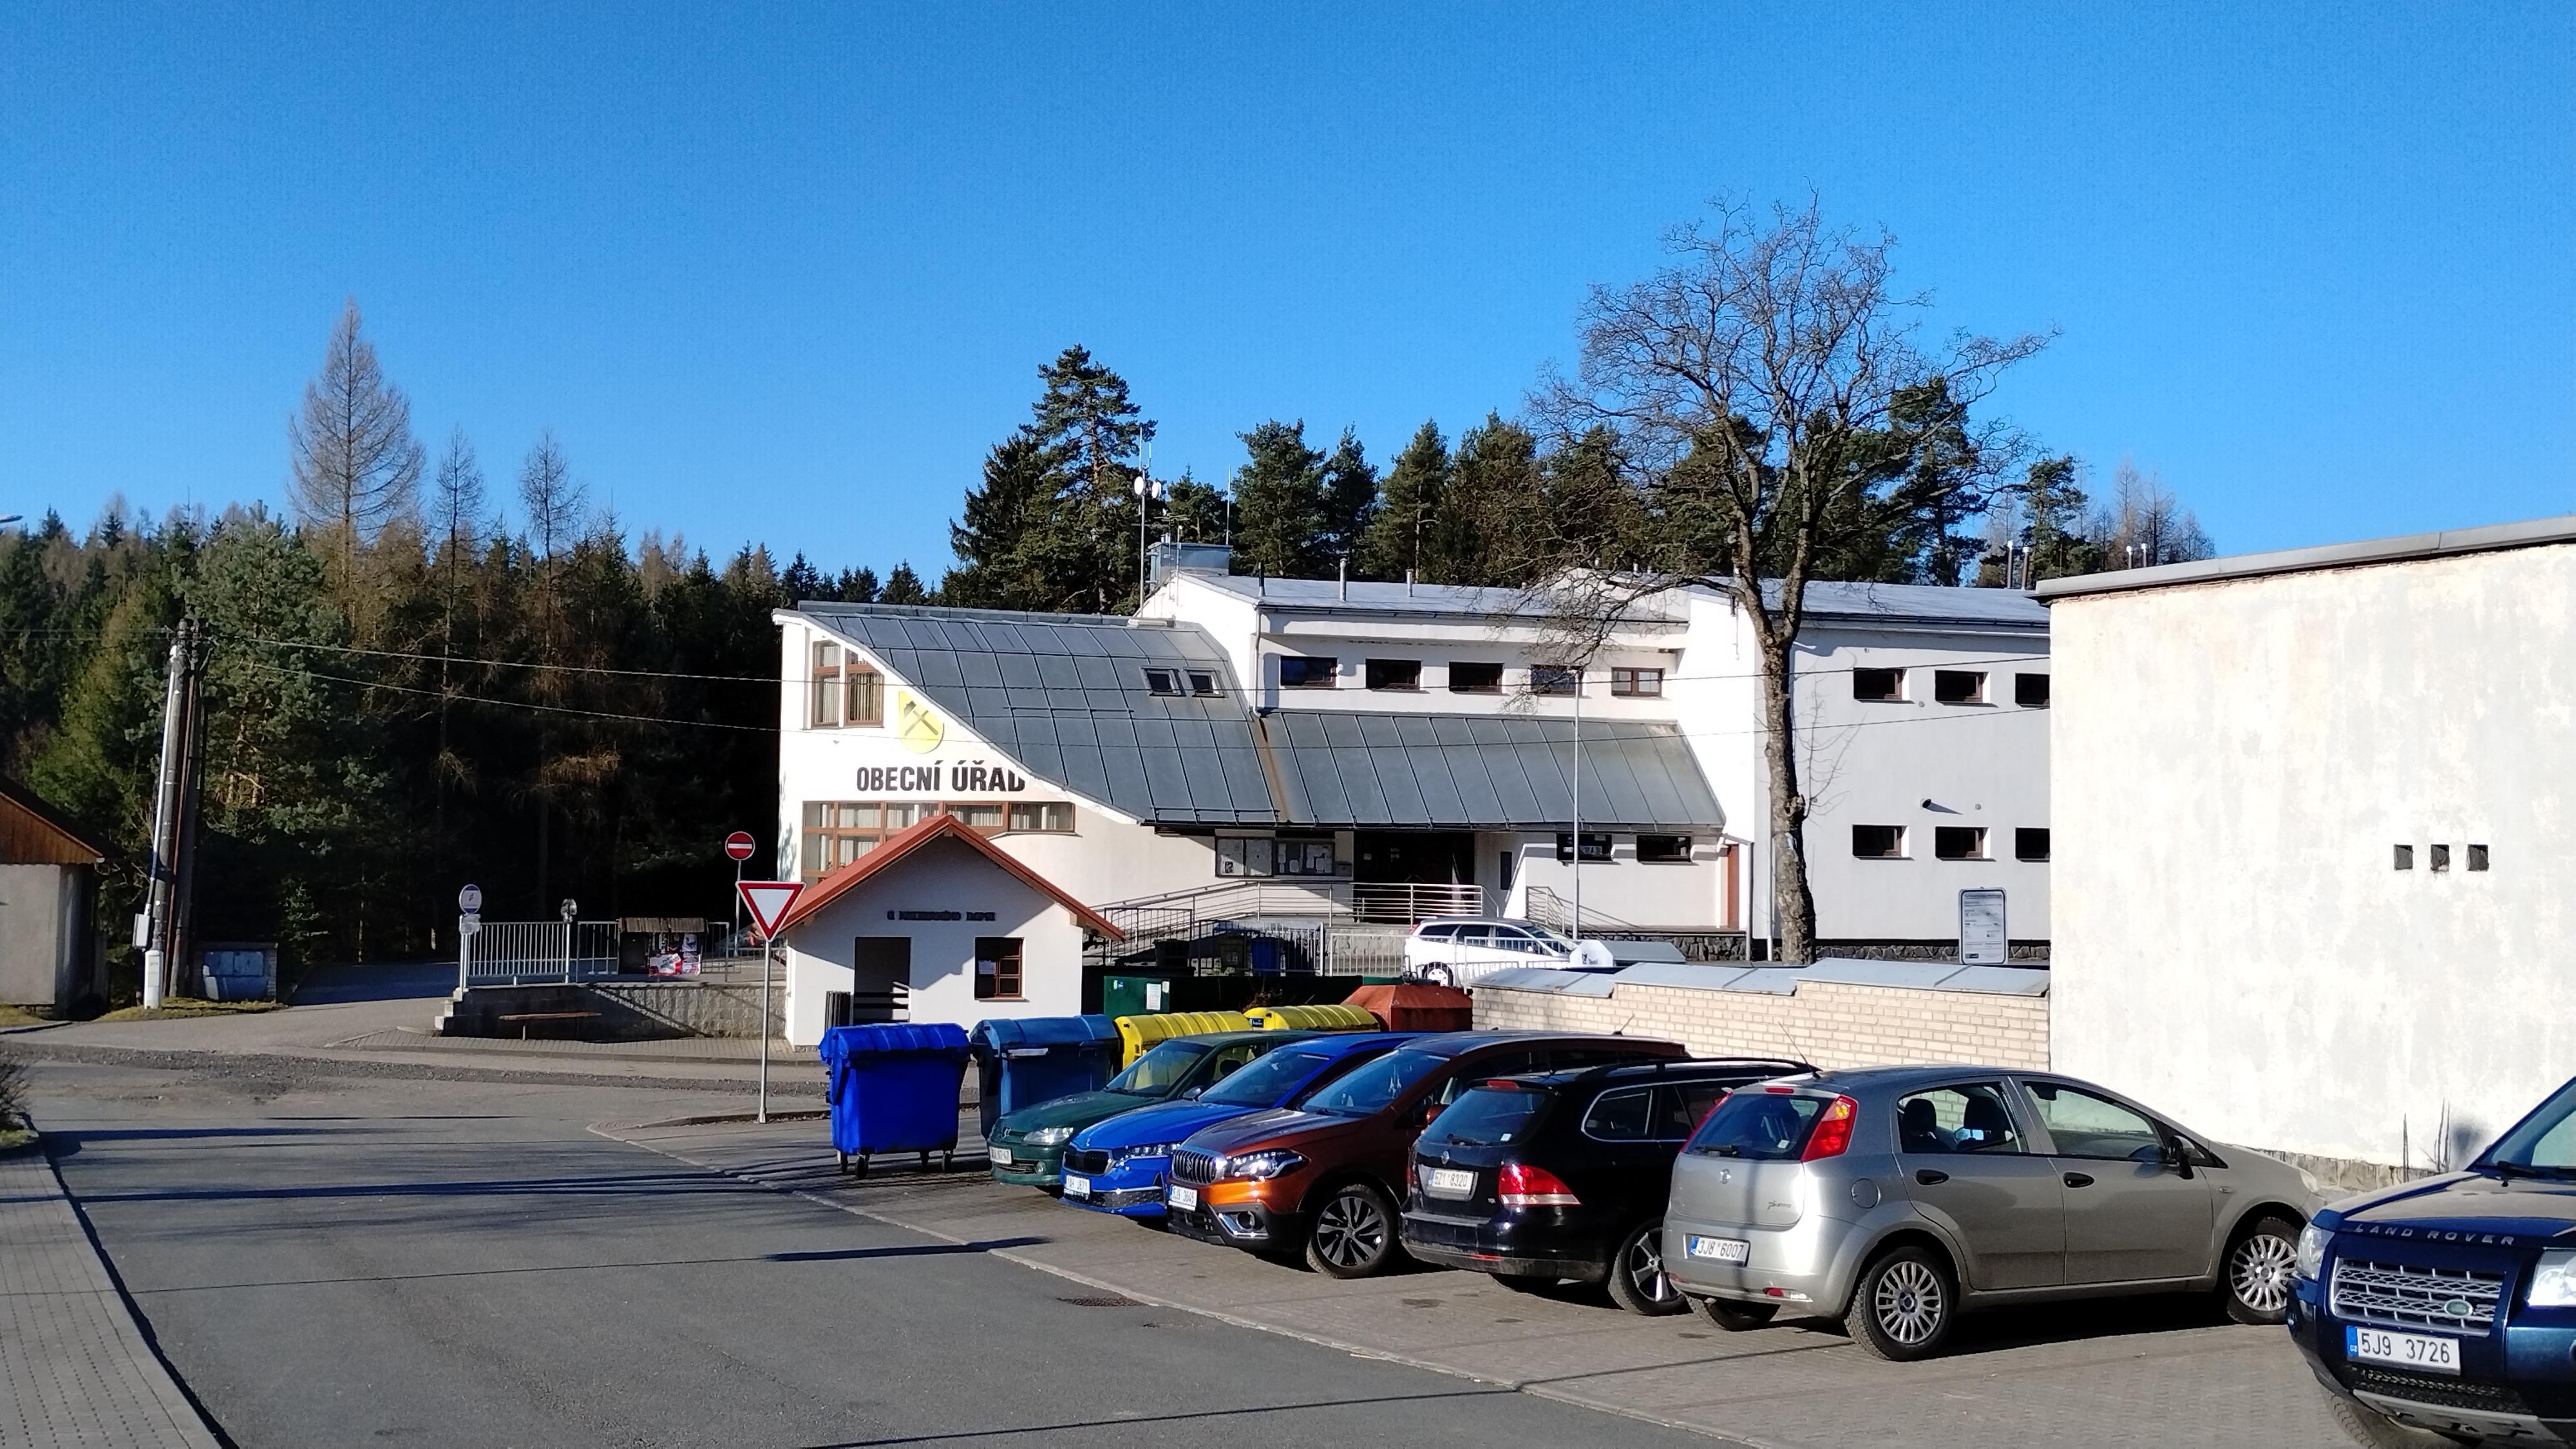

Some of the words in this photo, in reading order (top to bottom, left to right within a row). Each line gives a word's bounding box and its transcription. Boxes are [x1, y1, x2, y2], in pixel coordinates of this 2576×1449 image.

[857, 760, 943, 791] OBECNÍ
[952, 760, 1025, 791] ÚŘAD
[2354, 1224, 2414, 1237] LAND
[2427, 1230, 2515, 1245] ROVER
[1698, 1240, 1716, 1256] 3J8
[1719, 1242, 1745, 1259] 6007
[2361, 1332, 2392, 1356] 5J9
[2405, 1338, 2450, 1364] 3726
